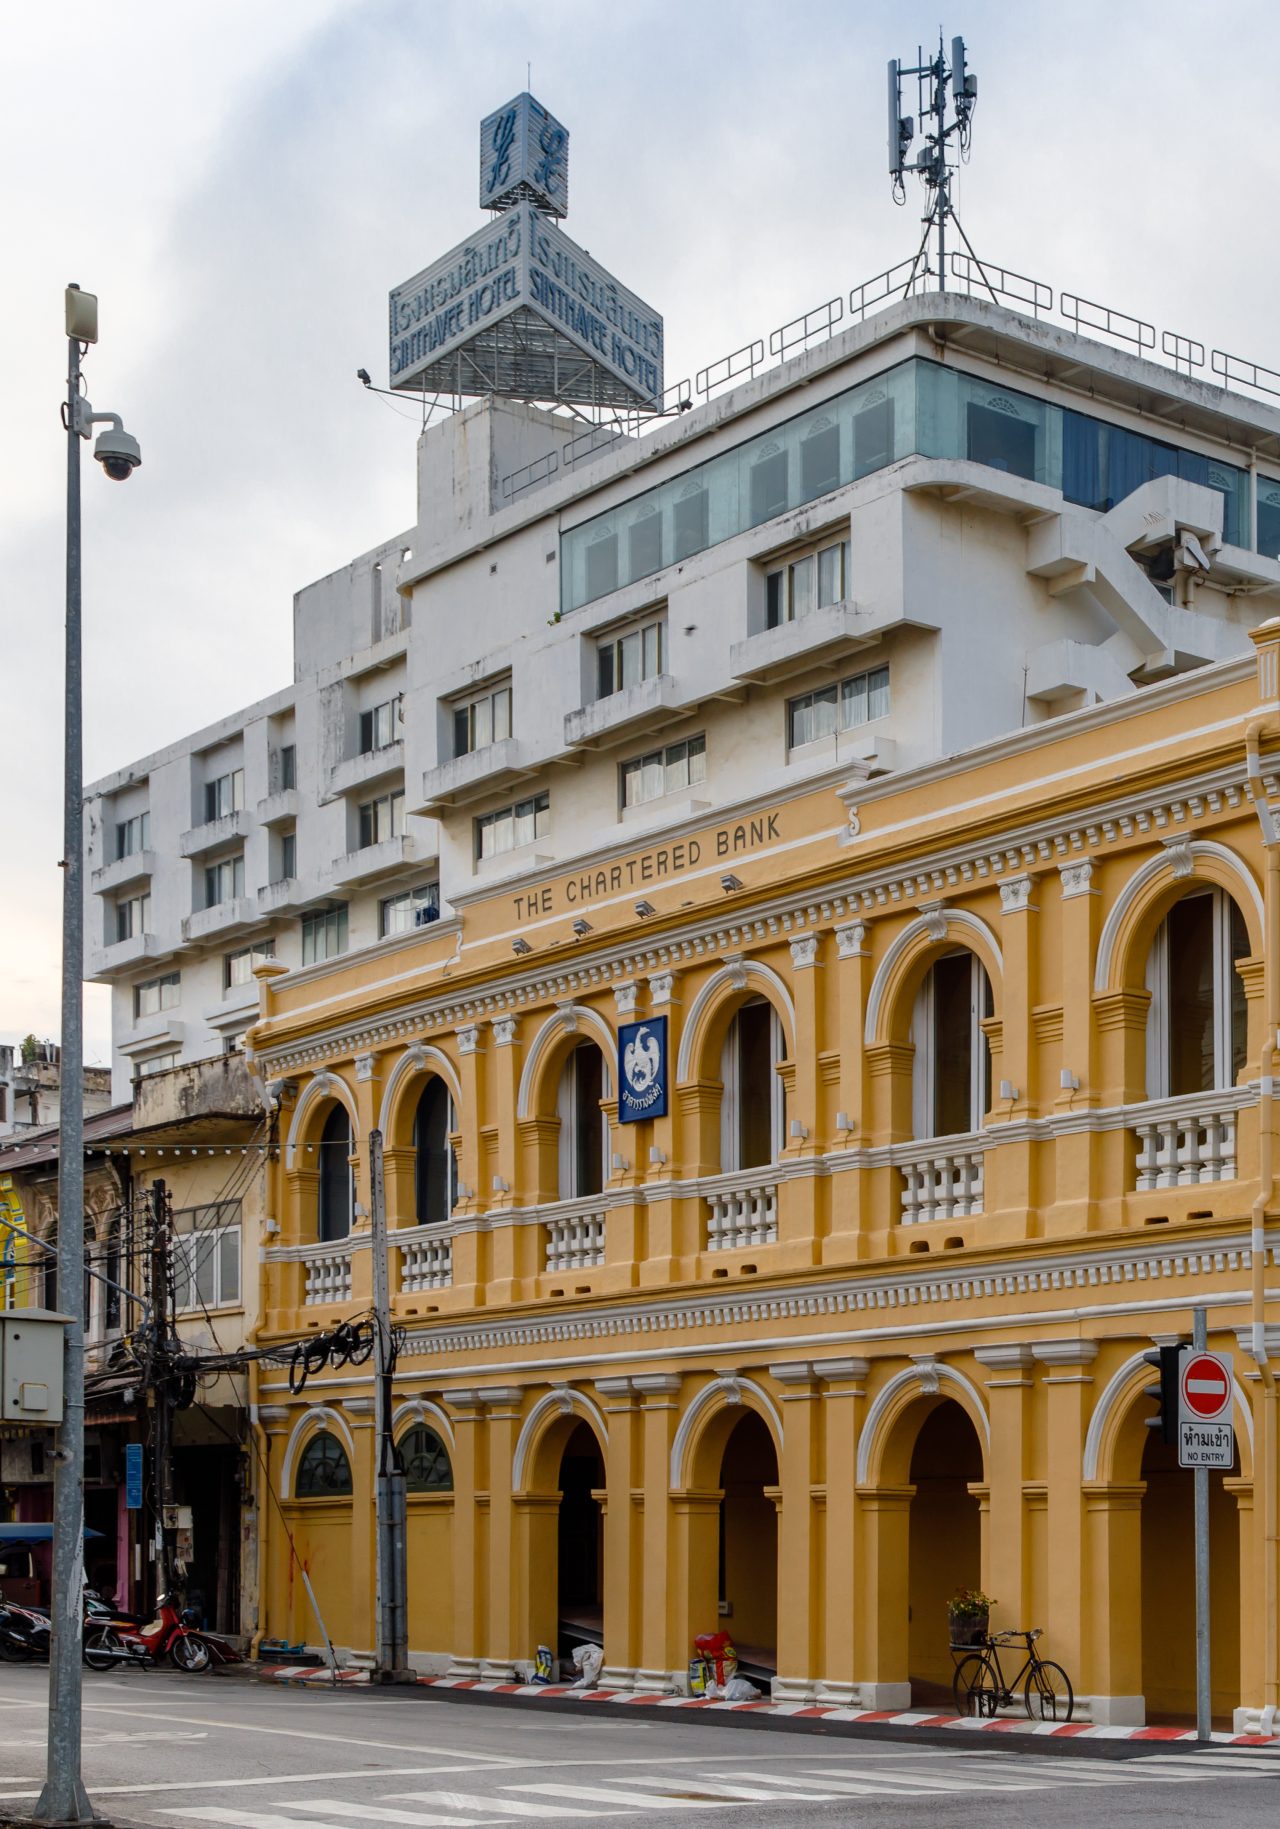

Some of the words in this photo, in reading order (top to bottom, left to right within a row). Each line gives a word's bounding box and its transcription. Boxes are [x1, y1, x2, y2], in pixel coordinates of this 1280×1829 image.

[391, 300, 465, 375] SINTHAVEE
[468, 265, 521, 325] HOTEL
[529, 266, 608, 357] SINTHAVEE
[611, 333, 659, 397] HOTEL
[513, 888, 553, 920] THE
[566, 840, 701, 903] CHARTERED
[716, 812, 781, 857] BANK
[1183, 1425, 1229, 1447] ห้ามเข้า
[1187, 1452, 1199, 1461] NO
[1201, 1452, 1225, 1462] ENTRY
